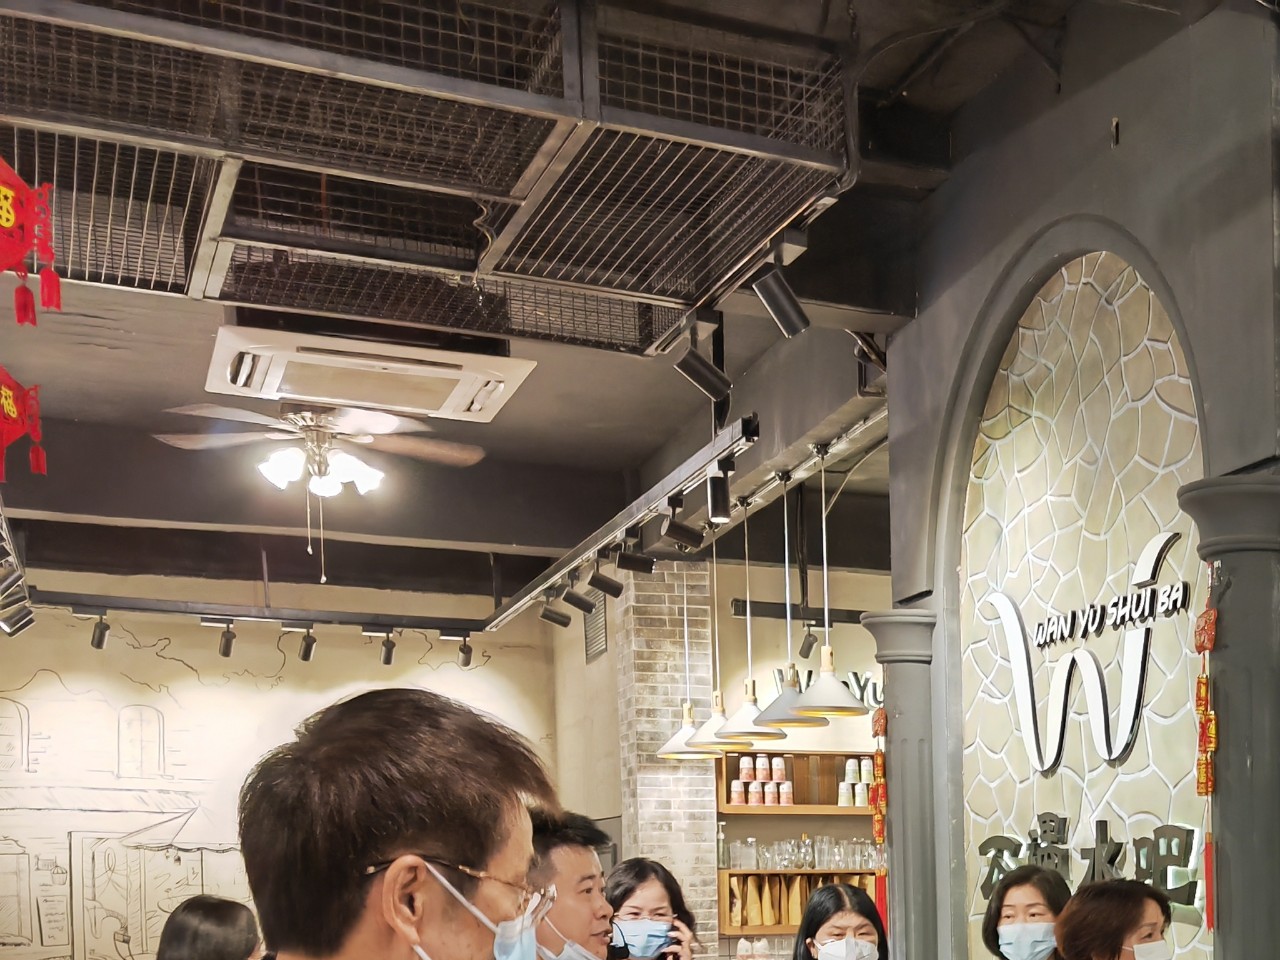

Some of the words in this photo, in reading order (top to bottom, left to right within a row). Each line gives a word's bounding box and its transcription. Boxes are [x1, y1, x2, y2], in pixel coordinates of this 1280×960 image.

[1032, 610, 1074, 648] WAN
[1078, 604, 1104, 639] YU
[1105, 588, 1154, 627] SHUI
[1157, 581, 1187, 614] BA
[773, 668, 884, 707] WYu
